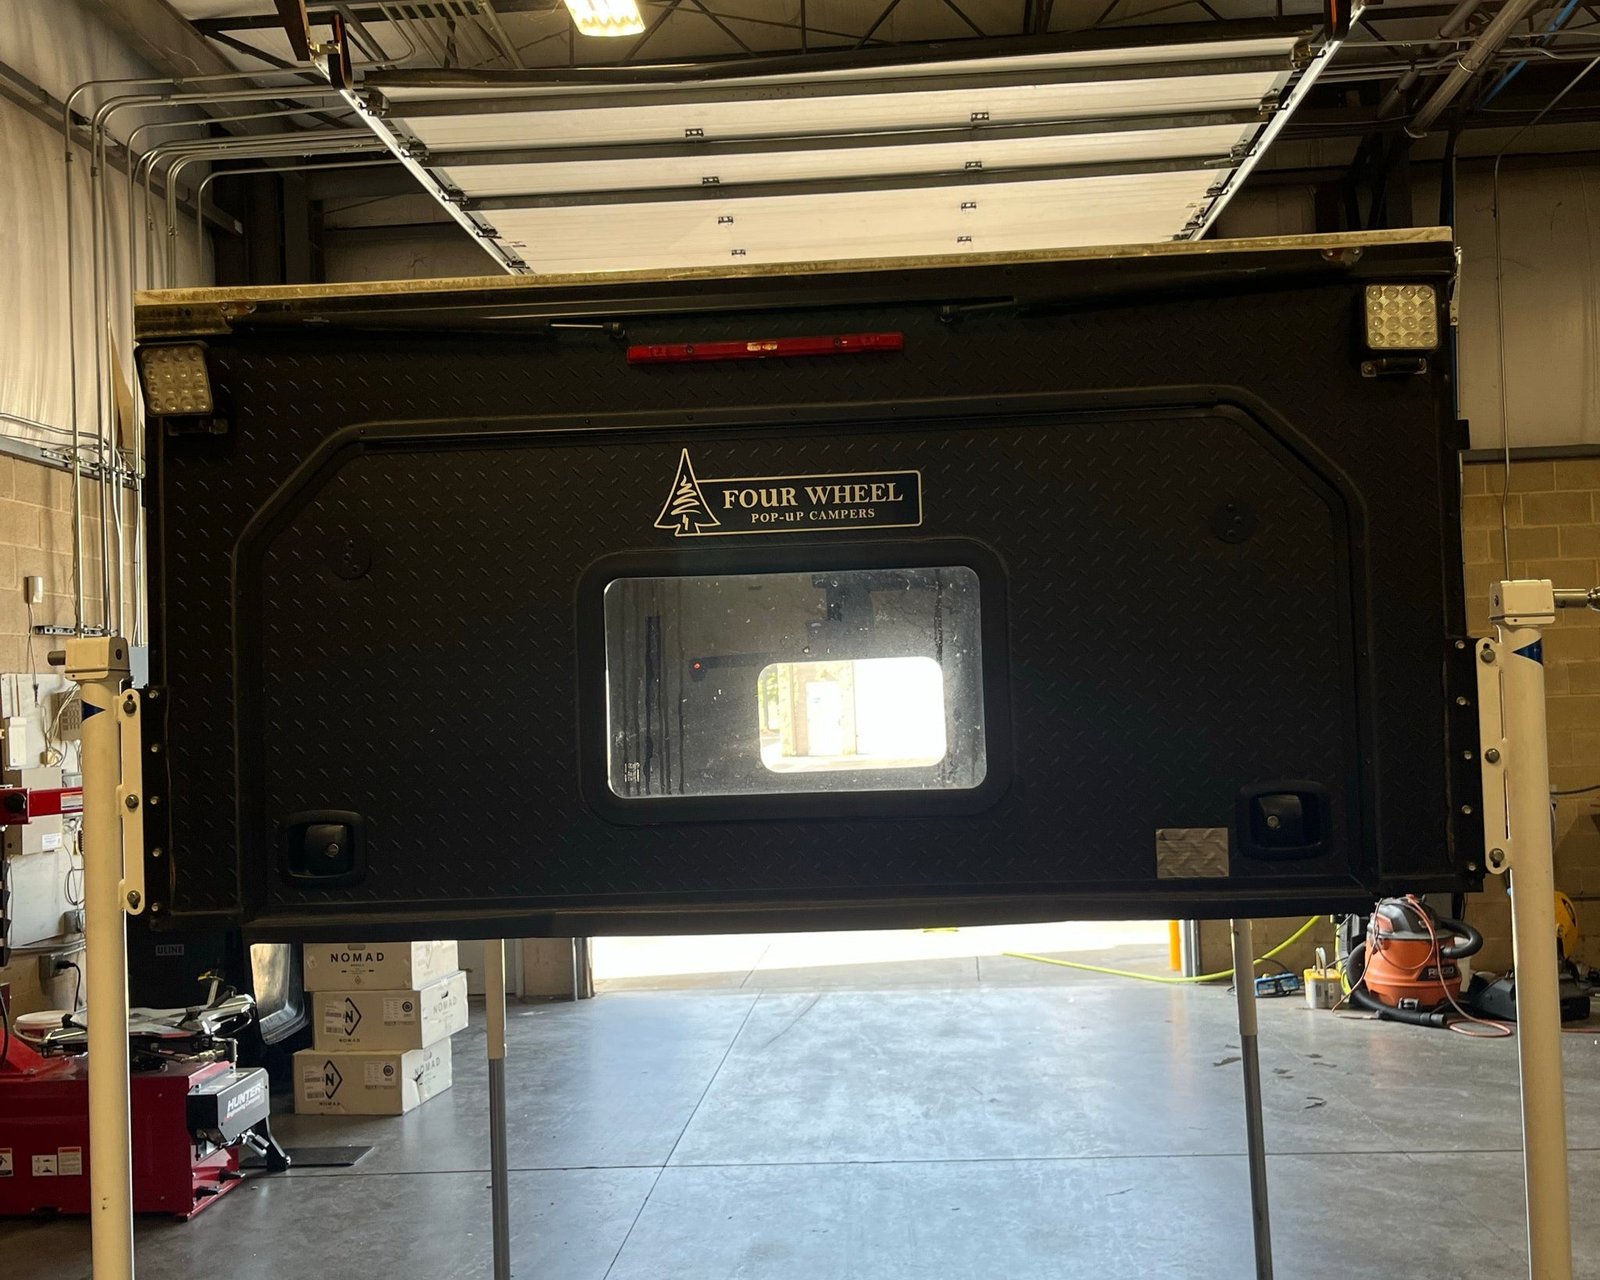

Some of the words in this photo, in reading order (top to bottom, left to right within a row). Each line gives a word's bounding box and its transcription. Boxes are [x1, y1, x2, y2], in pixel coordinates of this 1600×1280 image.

[722, 487, 798, 509] FOUR
[804, 482, 904, 505] WHEEL
[751, 510, 804, 524] POP-UP
[809, 508, 876, 521] CAMPERS
[157, 946, 183, 954] ULINE
[330, 953, 385, 963] NOMAD
[432, 997, 458, 1015] NOMAD
[345, 1010, 354, 1024] N
[414, 1057, 441, 1076] NOMAD
[325, 1072, 335, 1087] N
[227, 1082, 262, 1113] HUNTER
